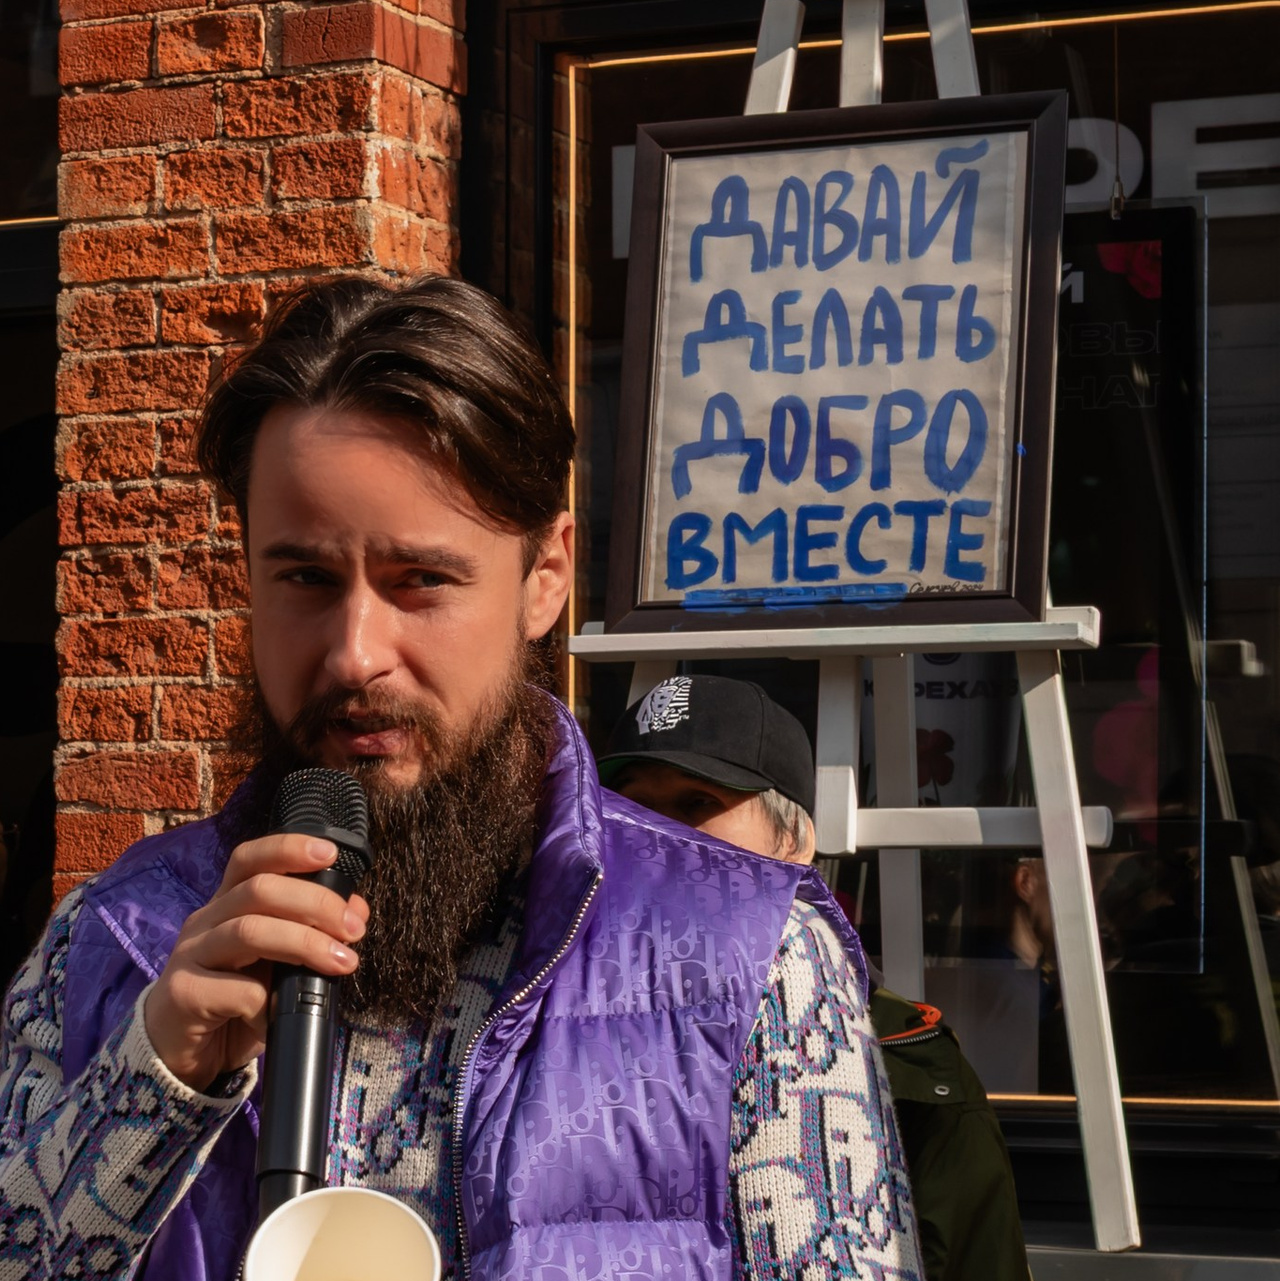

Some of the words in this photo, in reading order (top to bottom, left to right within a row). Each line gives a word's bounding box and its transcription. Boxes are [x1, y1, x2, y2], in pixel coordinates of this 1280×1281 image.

[689, 139, 989, 282] ДАВАЙ
[682, 284, 996, 378] ДЕЛАТЬ
[671, 388, 989, 500] ДОБРО
[665, 499, 993, 590] ВМЕСТЕ
